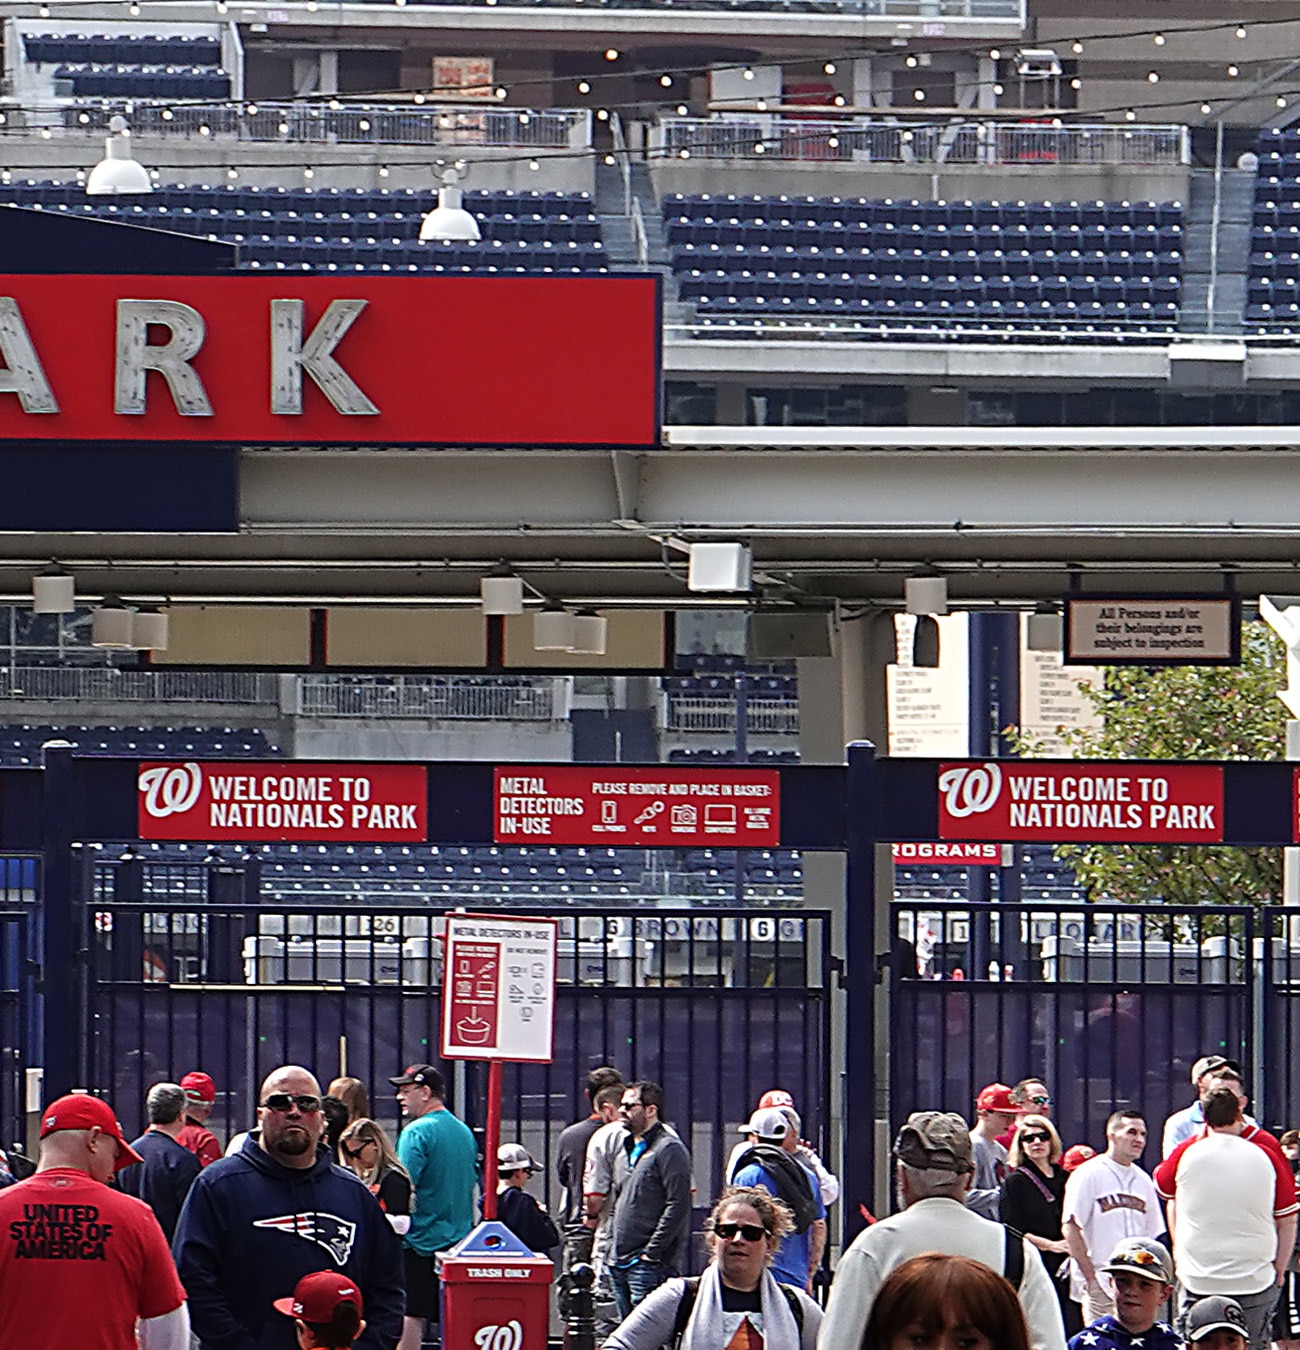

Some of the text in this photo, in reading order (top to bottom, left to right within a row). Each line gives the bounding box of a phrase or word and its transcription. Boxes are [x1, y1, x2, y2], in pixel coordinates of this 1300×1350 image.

[1099, 607, 1200, 620] All Persons and/or
[1096, 622, 1204, 637] their belongings are
[1094, 637, 1205, 651] subject to inspection
[138, 762, 203, 818] W
[208, 776, 371, 802] WELCOME TO
[499, 776, 548, 795] METAL
[592, 782, 628, 795] PLEASE
[629, 783, 667, 795] REMOVE
[668, 783, 688, 796] AND
[689, 783, 719, 796] PLACE
[721, 784, 733, 796] IN
[939, 762, 1002, 818] W
[1008, 776, 1168, 802] WELCOME TO
[210, 803, 418, 829] NATIONALS PARK
[499, 796, 584, 816] DETECTORS
[1010, 803, 1215, 829] NATIONALS PARK
[499, 816, 552, 835] IN-USE
[892, 843, 997, 858] ROGRAMS
[454, 927, 550, 940] METAL DETECTORS IN-USE
[24, 1203, 100, 1223] UNITED
[9, 1221, 113, 1242] STATES OF
[14, 1239, 107, 1262] AMERICA
[466, 1267, 532, 1278] TRASH ONLY
